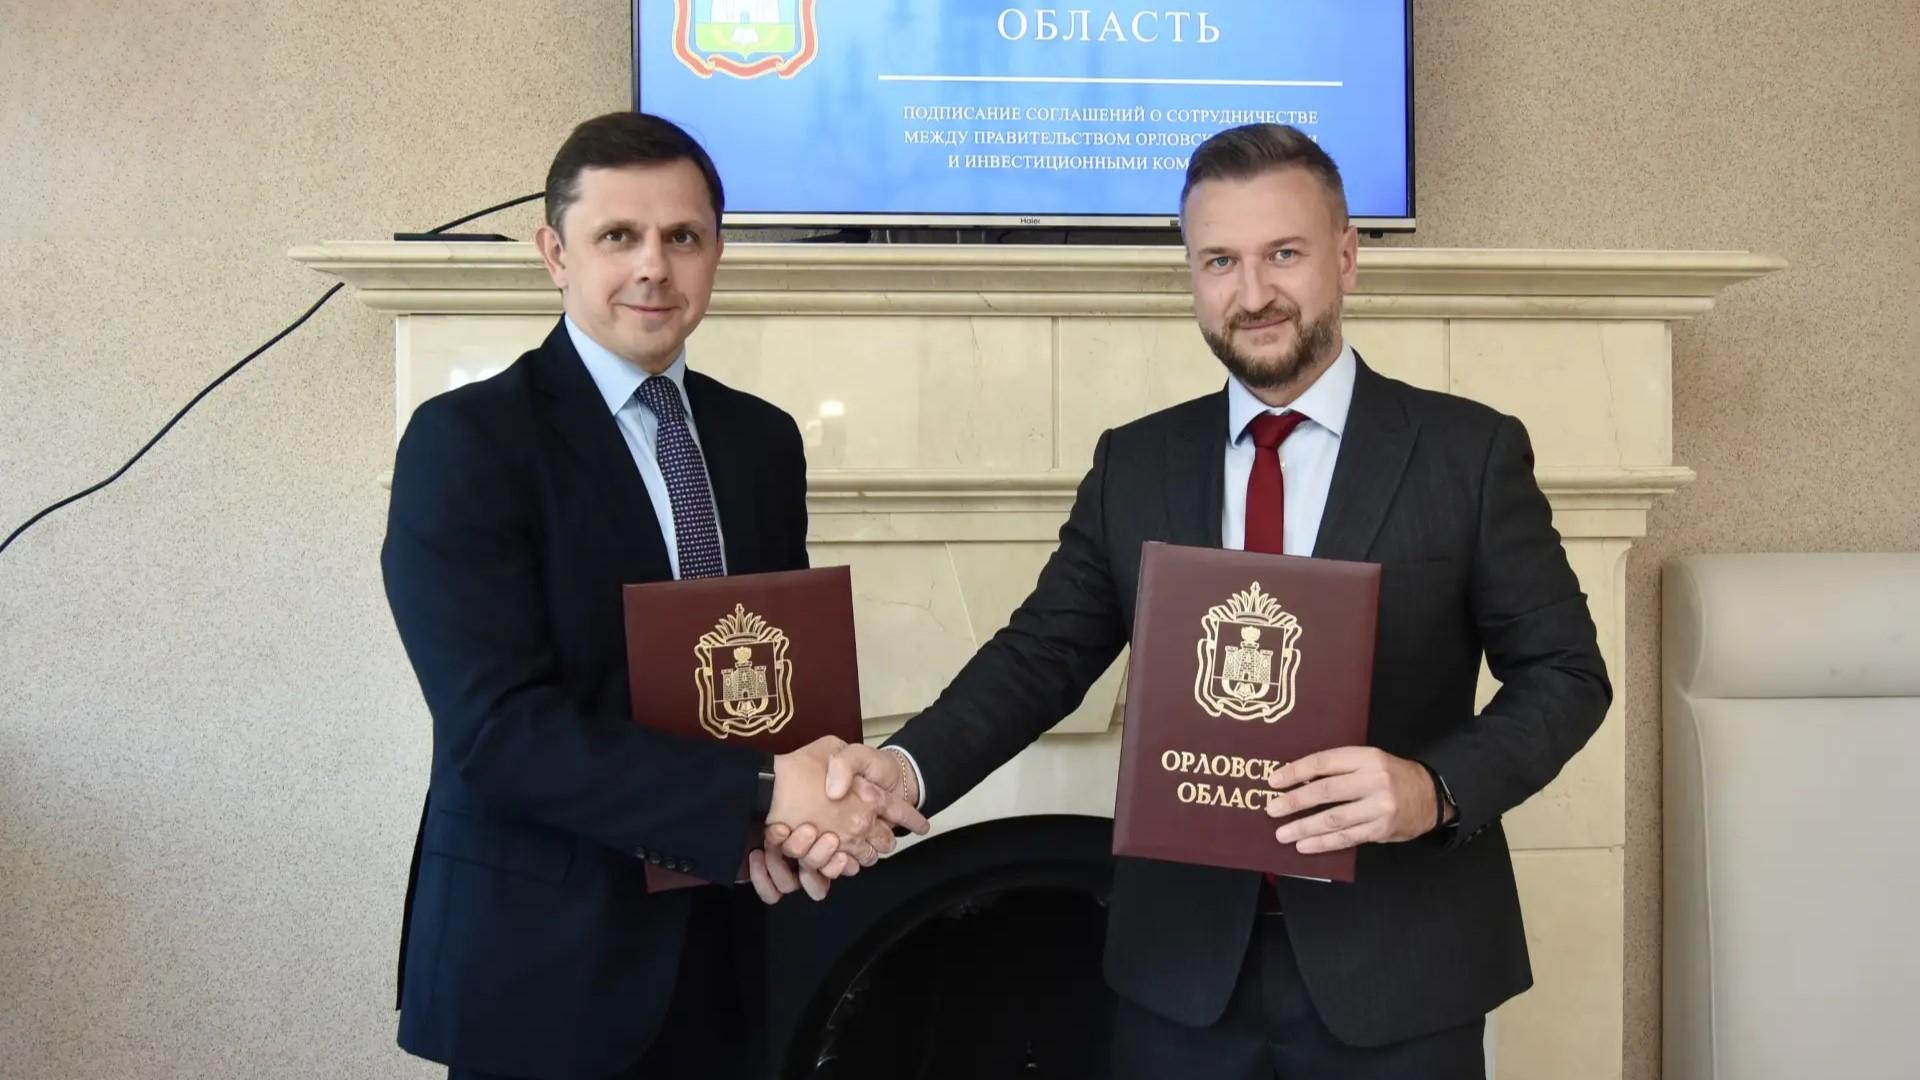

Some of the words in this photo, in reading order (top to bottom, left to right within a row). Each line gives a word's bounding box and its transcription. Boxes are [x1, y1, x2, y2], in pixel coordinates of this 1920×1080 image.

[997, 8, 1221, 43] ОБЛАСТЬ
[903, 106, 1021, 122] ПОДПИСАНИЕ
[1026, 106, 1145, 122] СОГЛАШЕНИЙ
[1150, 109, 1162, 122] О
[1167, 109, 1319, 125] СОТРУДНИЧЕСТВЕ
[904, 131, 968, 146] МЕЖДУ
[974, 131, 1130, 146] ПРАВИТЕЛЬСТВОМ
[948, 155, 960, 169] И
[965, 155, 1147, 171] ИНВЕСТИЦИОННЫМИ
[1153, 157, 1188, 170] КОМ
[1161, 750, 1283, 781] ОРЛОВСК
[1177, 782, 1284, 811] ОБЛАСТ
